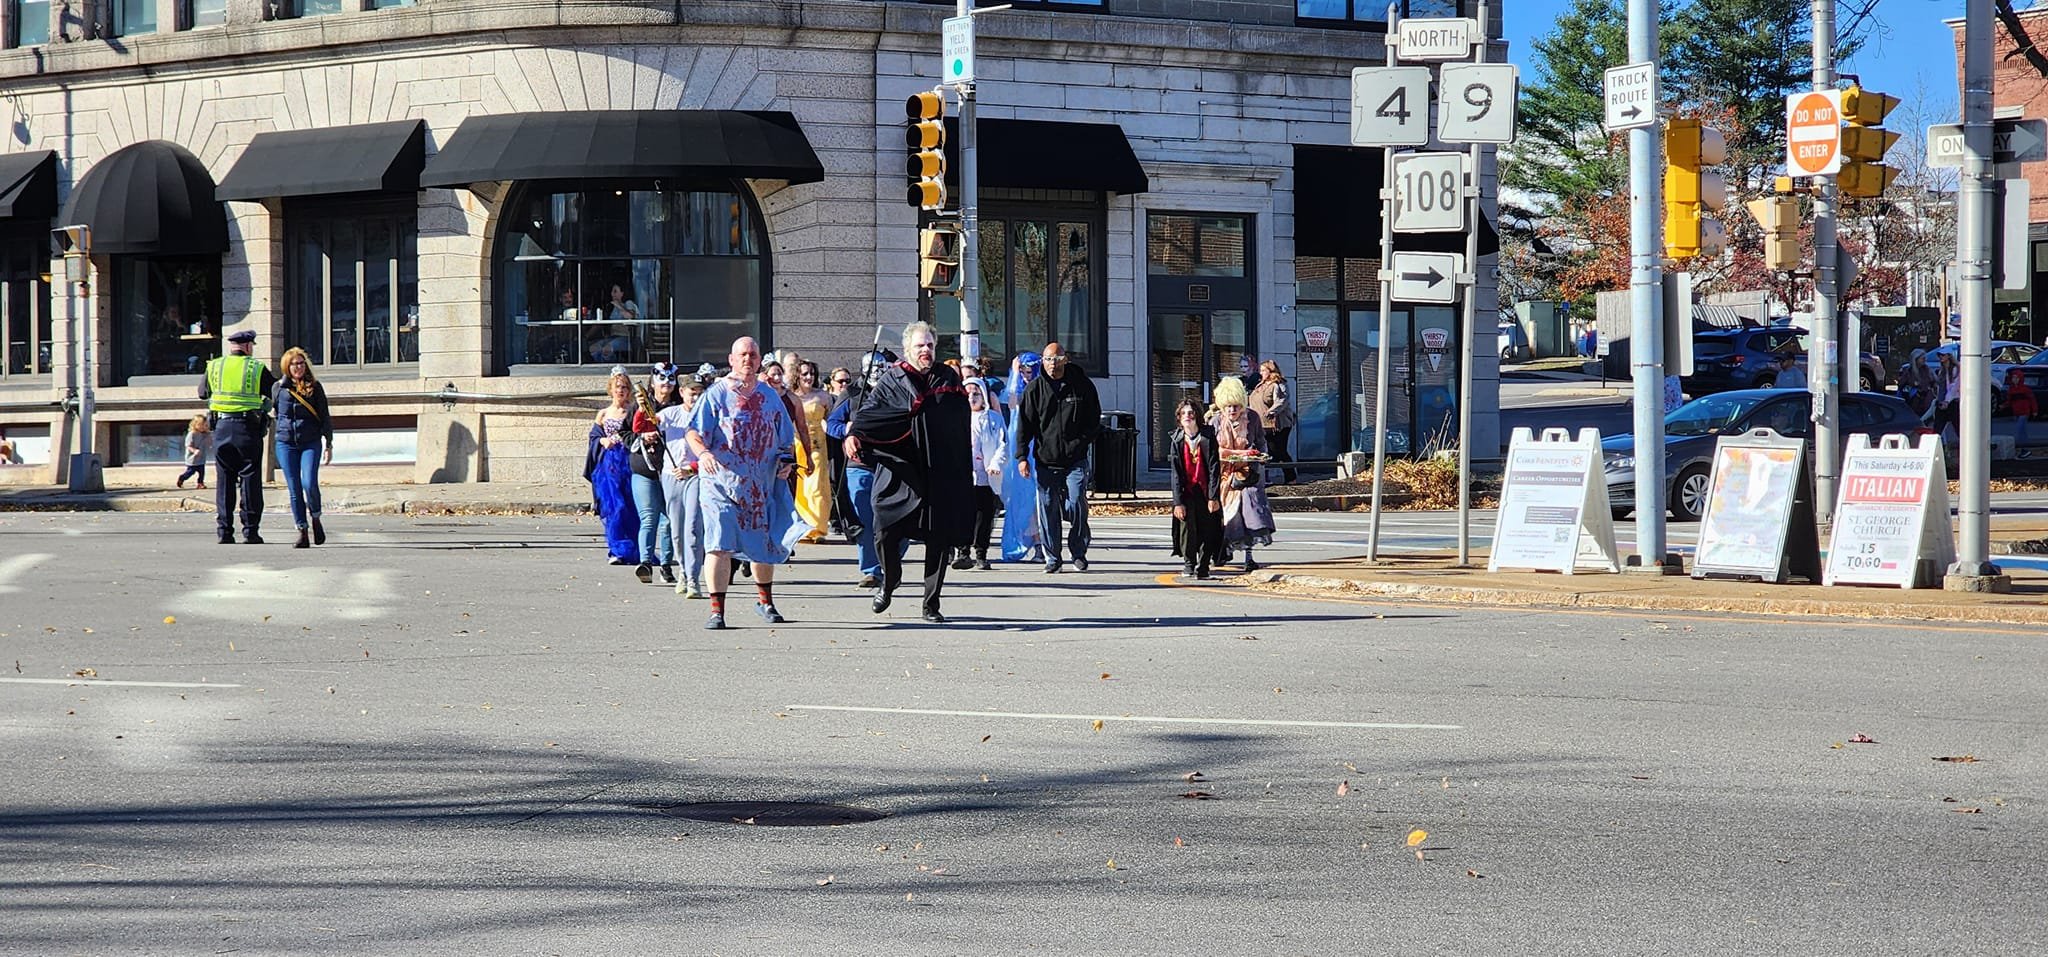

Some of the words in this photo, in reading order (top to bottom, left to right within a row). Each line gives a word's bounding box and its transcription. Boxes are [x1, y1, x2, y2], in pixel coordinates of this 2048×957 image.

[950, 33, 965, 45] YIELD
[1408, 29, 1459, 47] NORTH
[946, 48, 953, 56] ON
[955, 46, 969, 55] GREEN
[1611, 70, 1648, 88] TRUCK
[1463, 83, 1493, 122] 9
[1611, 88, 1648, 105] ROUTE
[1375, 86, 1411, 126] 4
[1796, 109, 1809, 123] DO
[1814, 107, 1833, 121] NOT
[1799, 143, 1828, 158] ENTER
[1941, 137, 1963, 153] ON
[1993, 133, 2011, 151] AY
[1404, 170, 1455, 212] 108
[1306, 331, 1329, 339] THIRSTY
[1854, 460, 1869, 470] This
[1870, 460, 1901, 471] Saturday
[1902, 461, 1924, 470] 4-6:00
[1535, 475, 1582, 483] OPPORTUNITIES
[1851, 477, 1917, 498] ITALIAN
[1865, 515, 1912, 525] GEORGE
[1853, 525, 1902, 535] CHURCH
[1860, 543, 1876, 554] 15
[1847, 556, 1861, 568] TO
[1865, 556, 1881, 568] GO
